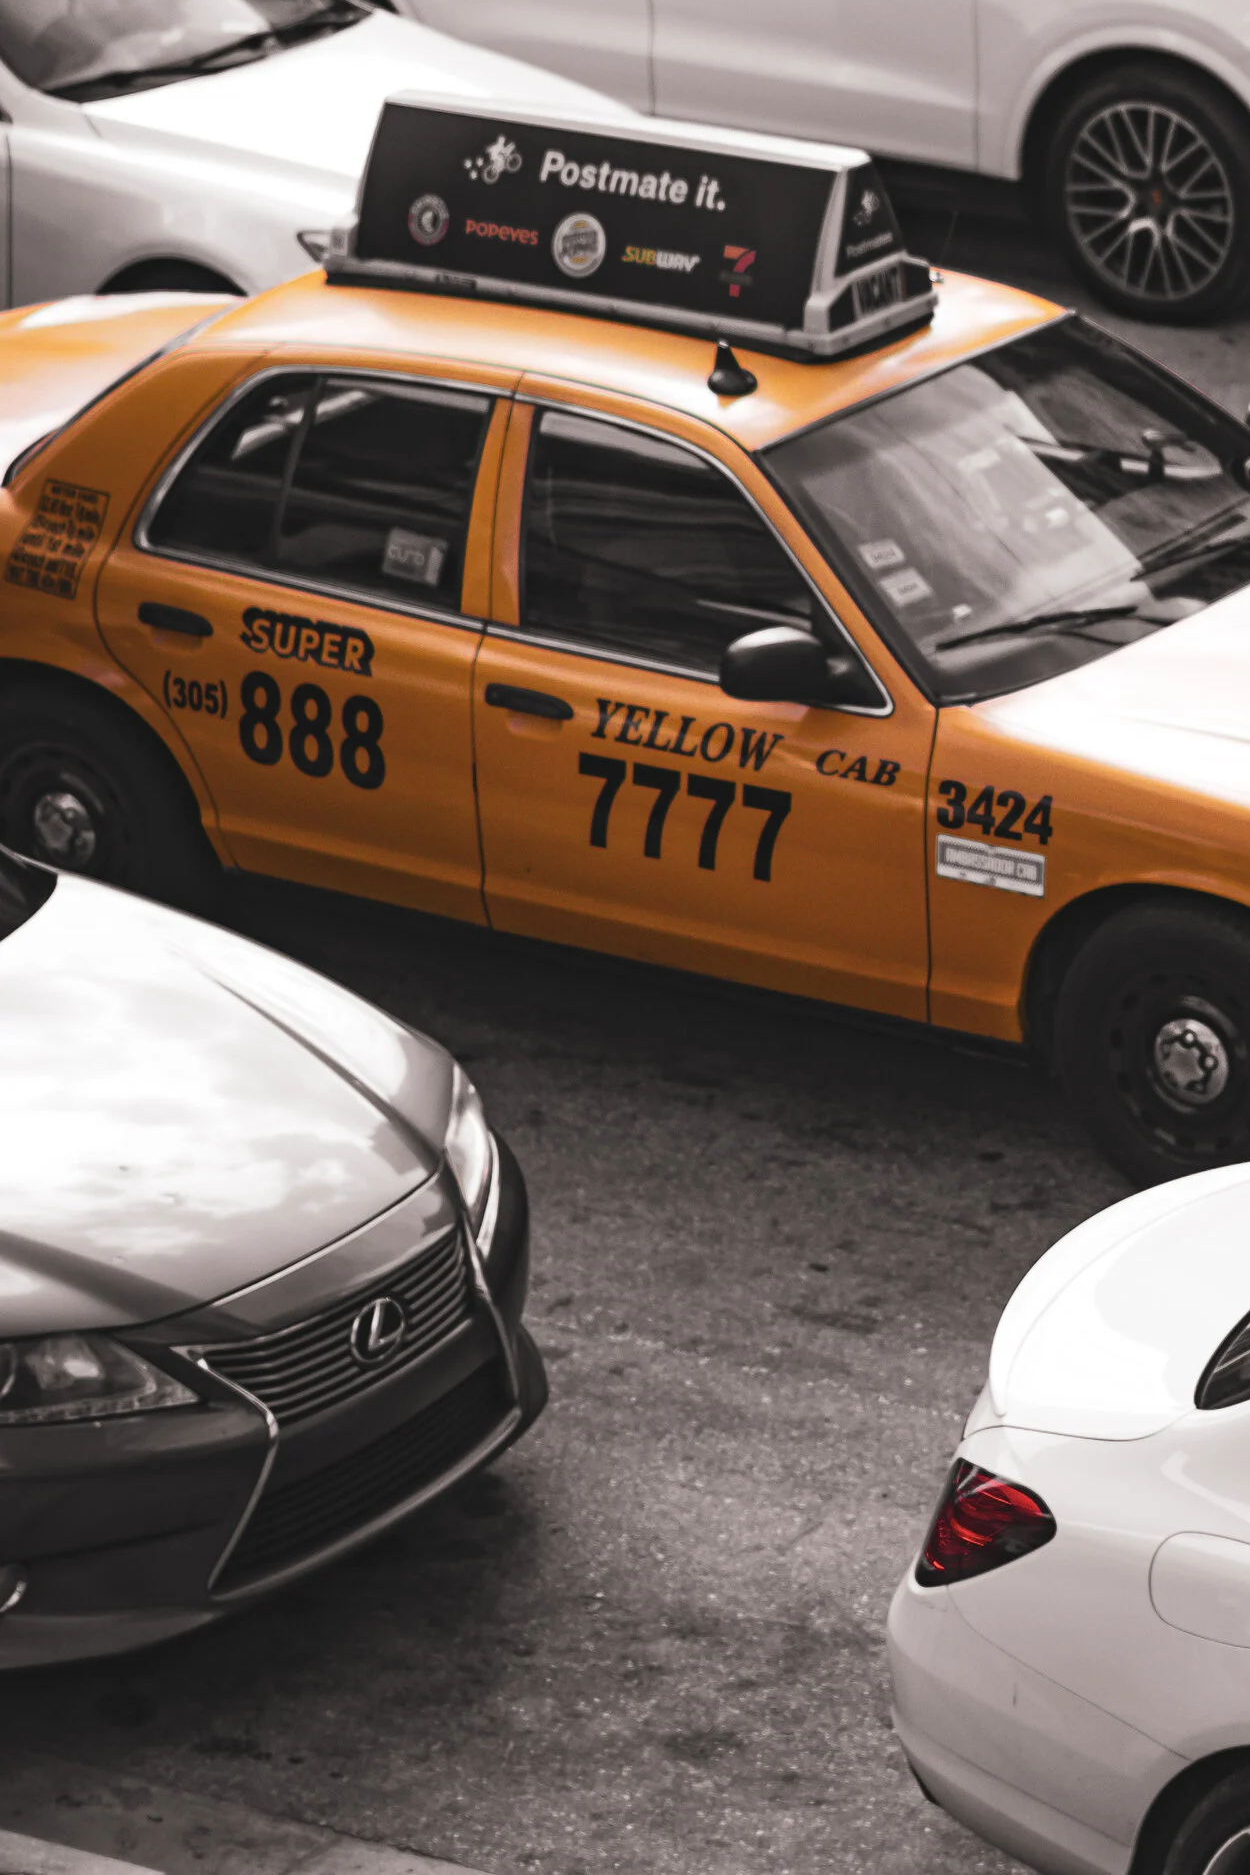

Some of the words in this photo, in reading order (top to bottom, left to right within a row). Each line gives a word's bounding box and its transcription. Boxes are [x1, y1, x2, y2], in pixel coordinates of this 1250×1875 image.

[540, 150, 688, 206] Postmate
[694, 175, 727, 212] it.
[621, 246, 700, 273] SUBWAY
[243, 610, 372, 675] SUPER
[163, 670, 228, 718] (305)
[239, 671, 386, 790] 888
[589, 698, 784, 772] YELLOW
[815, 747, 901, 787] CAB
[578, 752, 792, 882] 7777
[937, 779, 1053, 845] 3424
